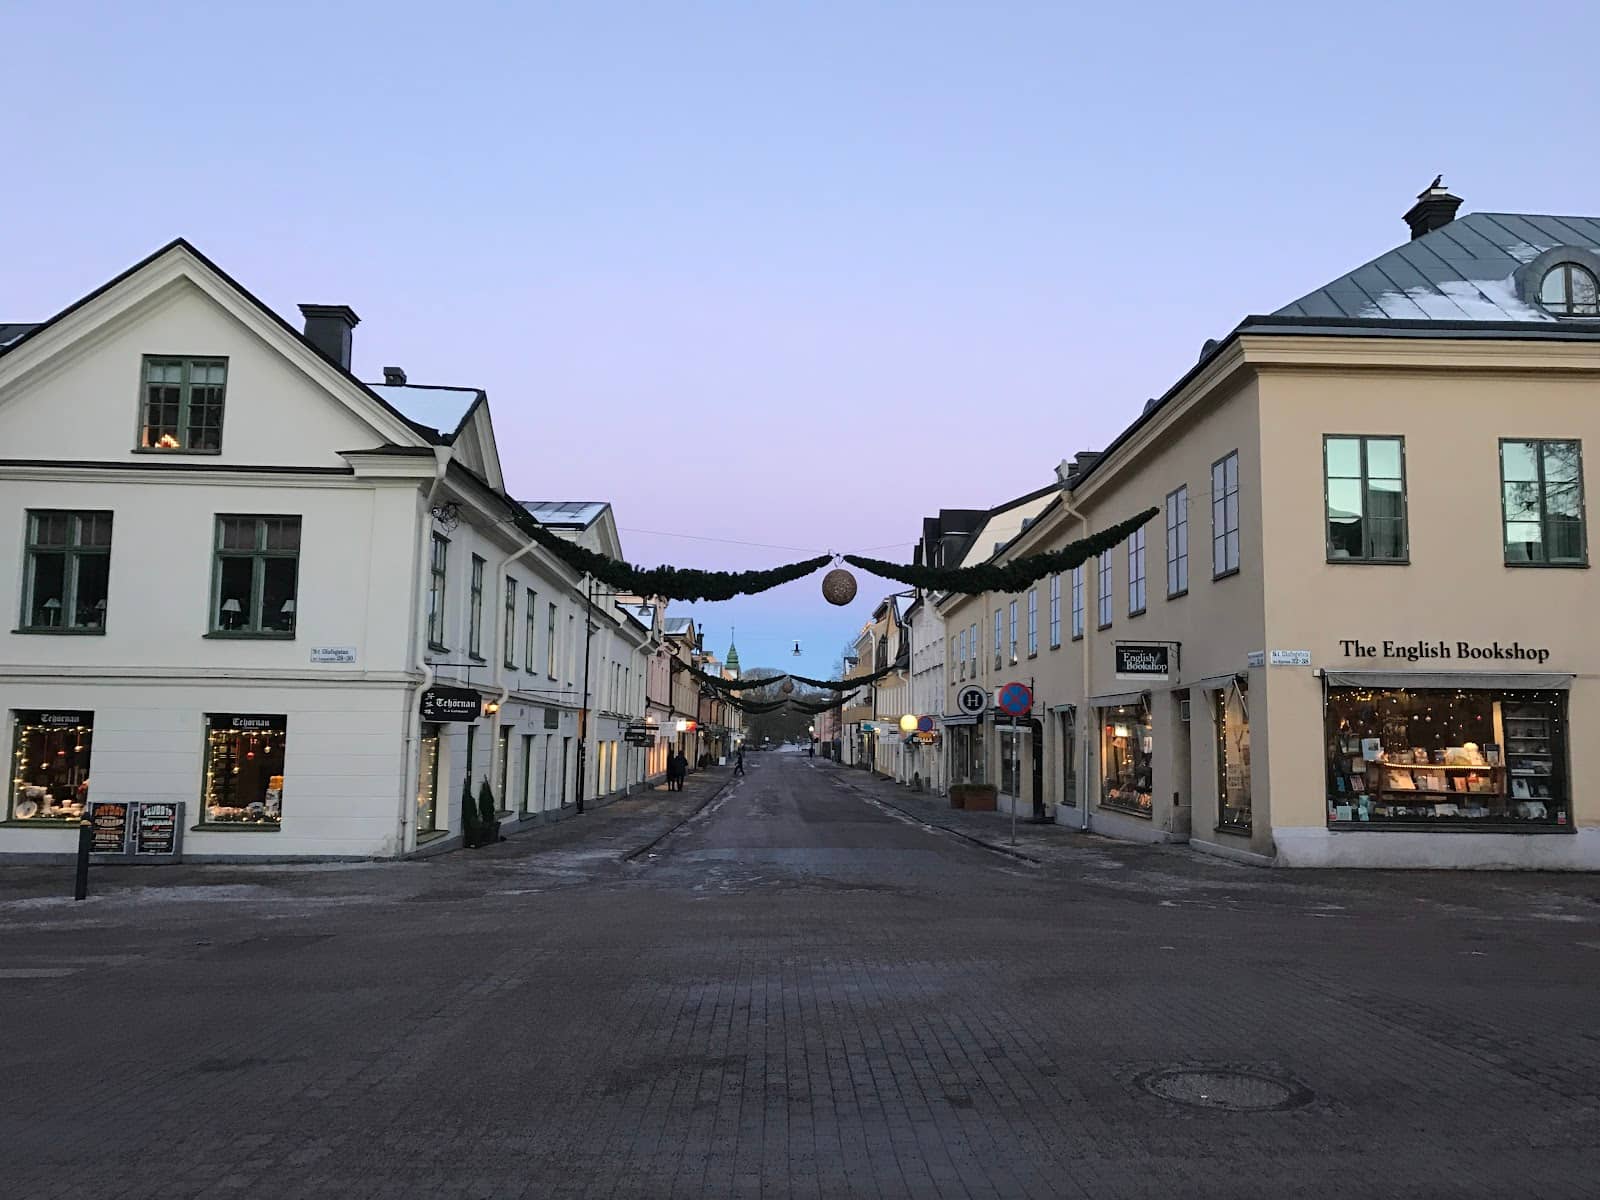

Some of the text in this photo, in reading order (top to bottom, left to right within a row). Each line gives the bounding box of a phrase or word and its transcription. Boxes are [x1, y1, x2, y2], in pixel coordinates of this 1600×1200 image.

[1123, 652, 1155, 664] English
[1339, 640, 1550, 664] The English Bookshop
[1126, 660, 1167, 673] Bookshop
[436, 698, 476, 709] Tehörnan
[967, 694, 979, 707] H
